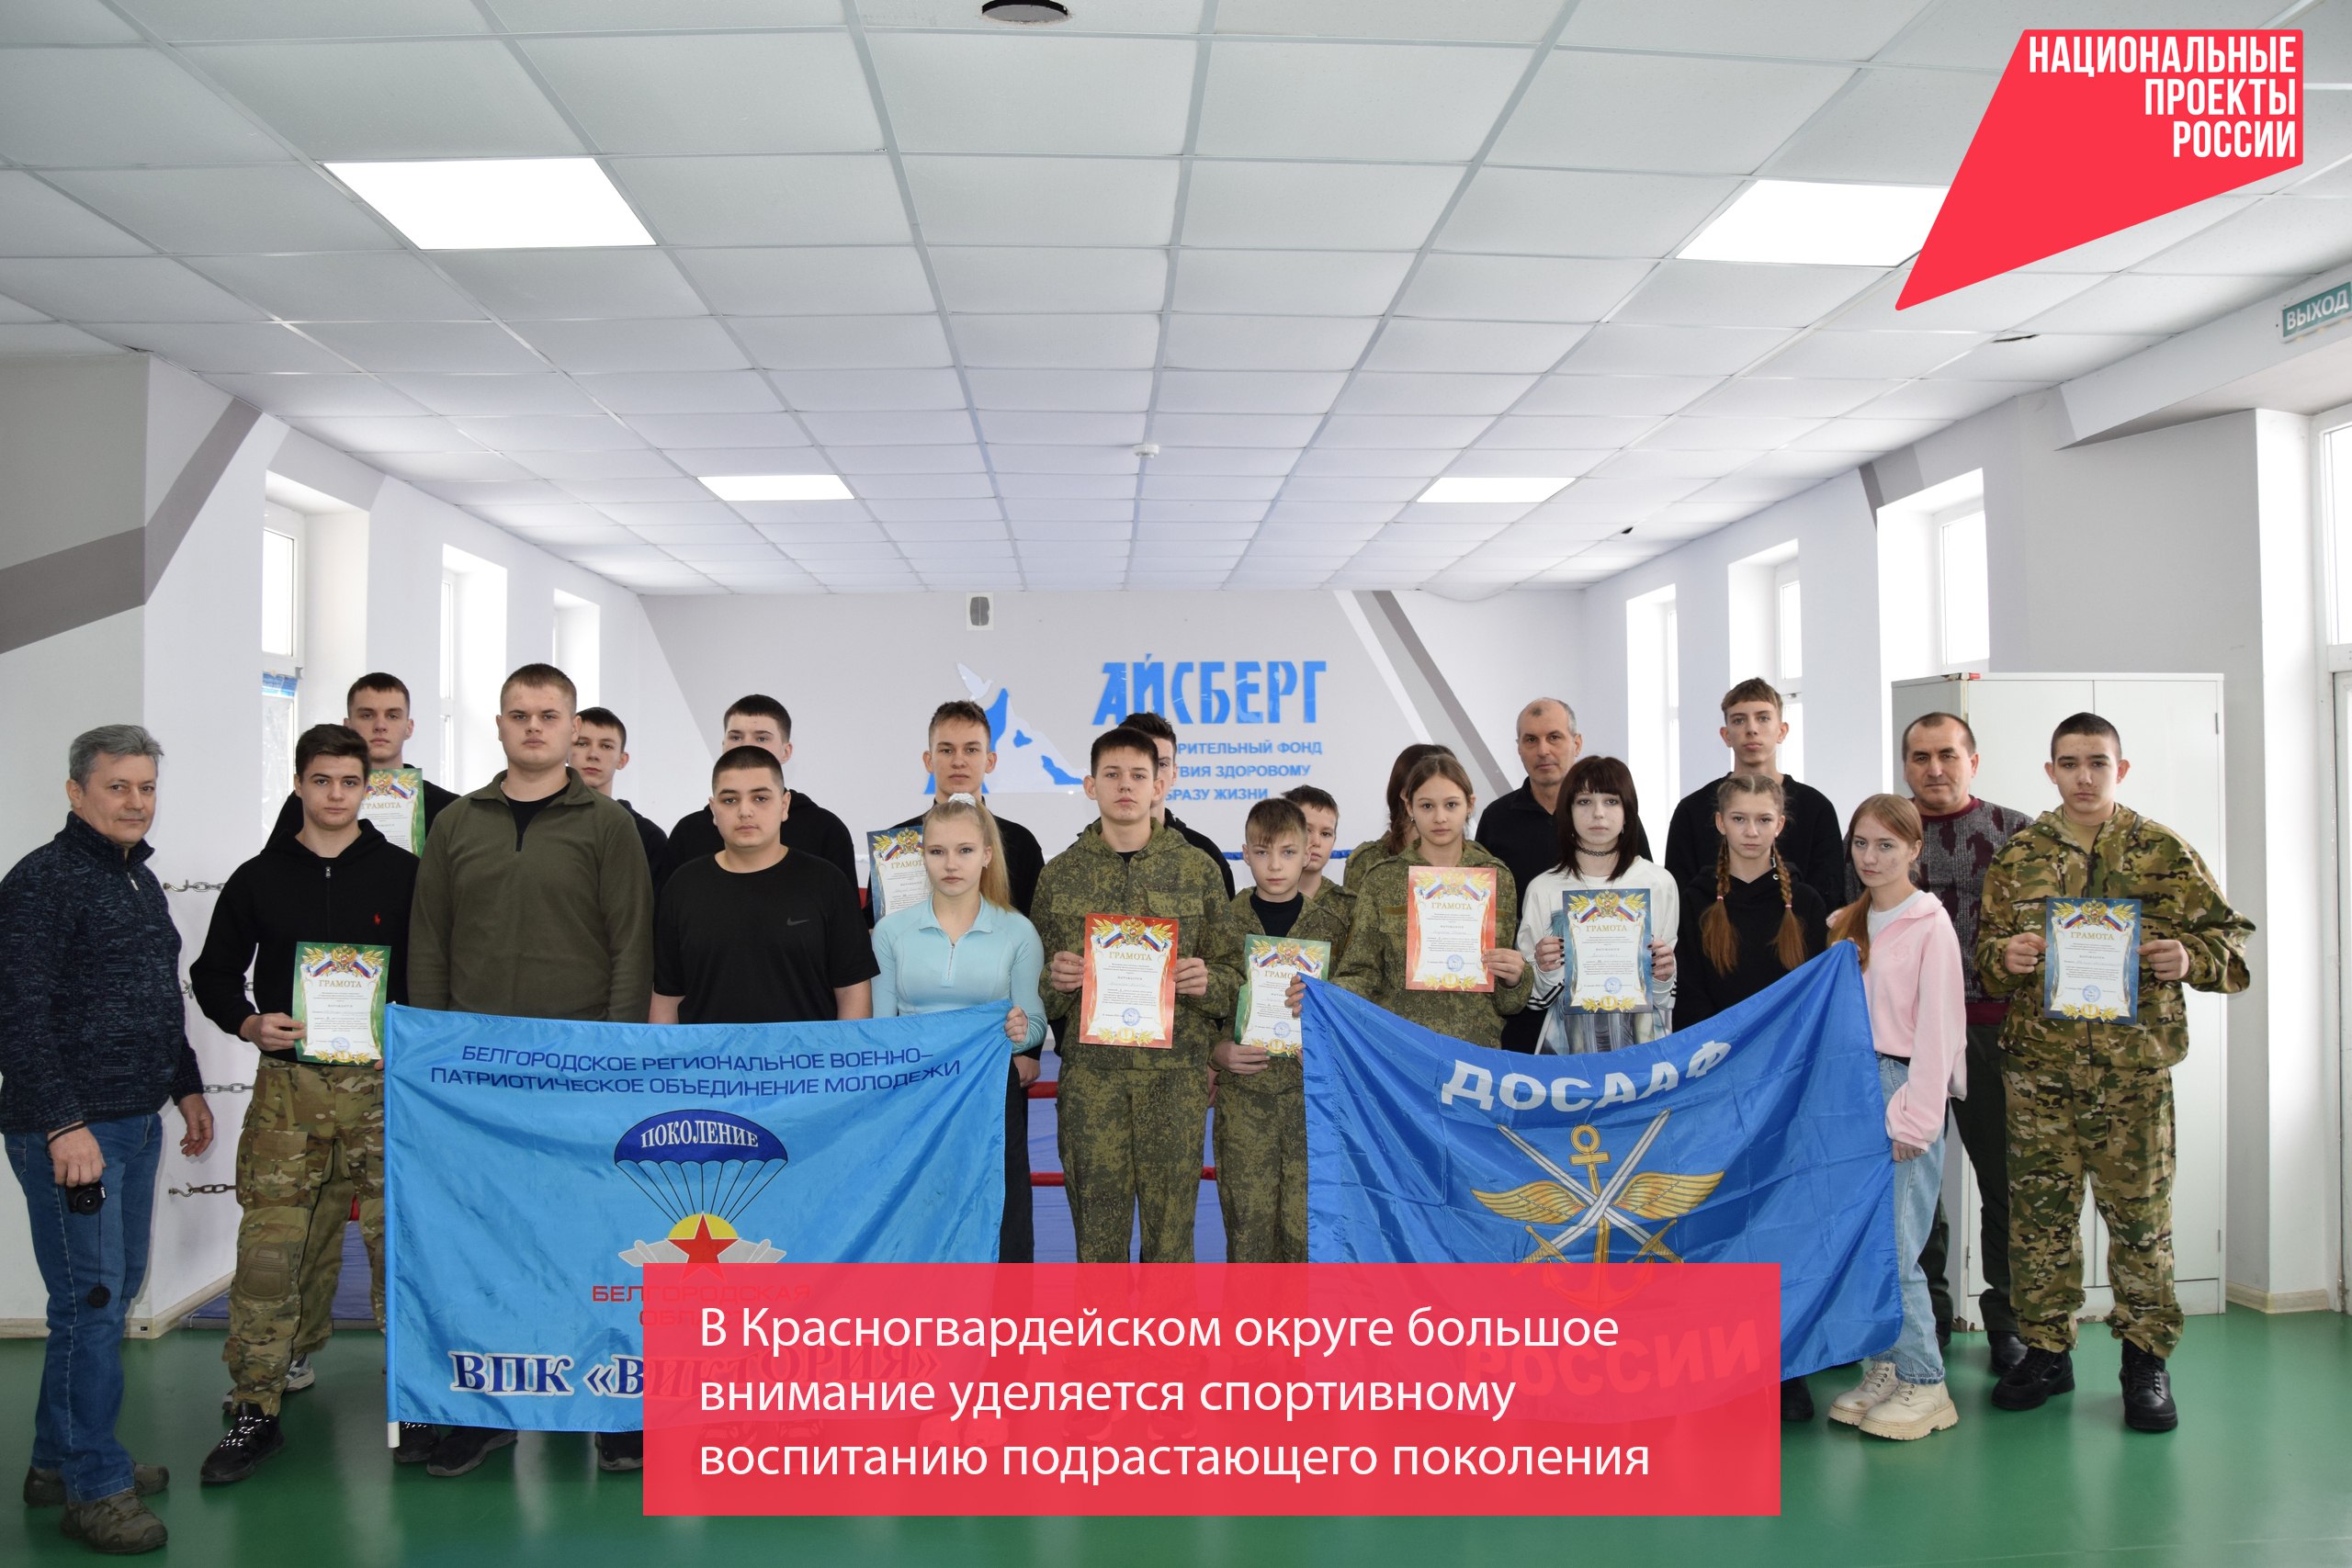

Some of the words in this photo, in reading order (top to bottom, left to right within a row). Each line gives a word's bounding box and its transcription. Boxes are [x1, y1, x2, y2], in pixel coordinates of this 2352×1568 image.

[2286, 289, 2349, 331] ВЫХОД
[1091, 653, 1328, 726] АЙСБЕРГ
[1177, 739, 1273, 755] РИТЕЛЬНЫЙ
[1277, 741, 1323, 755] ФОНД
[1216, 764, 1311, 779] ЗДОРОВОМУ
[1214, 787, 1270, 801] ЖИЗНИ
[891, 860, 924, 869] ГРАМОТ
[1587, 924, 1628, 932] ГРАМОТА
[2071, 931, 2115, 941] ГРАМОТА
[1109, 952, 1152, 962] ГРАМОТА
[1264, 970, 1296, 979] ГРАМО
[319, 979, 362, 988] ГРАМОТА
[461, 1045, 638, 1073] БЕЛГОРОДСКОЕ
[641, 1048, 826, 1073] РЕГИОНАЛЬНОЕ
[430, 1066, 645, 1094] ПАТРИОТИЧЕСКОЕ
[649, 1077, 819, 1100] ОБЪЕДИНЕНИЕ
[824, 1059, 961, 1094] МОЛОДЕЖИ
[1441, 1040, 1732, 1111] ДОСААФ
[640, 1120, 759, 1148] ПОКОЛЕНИЕ
[592, 1284, 810, 1304] БЕЛГОРОДСКАЯ
[452, 1353, 573, 1395] ВПК
